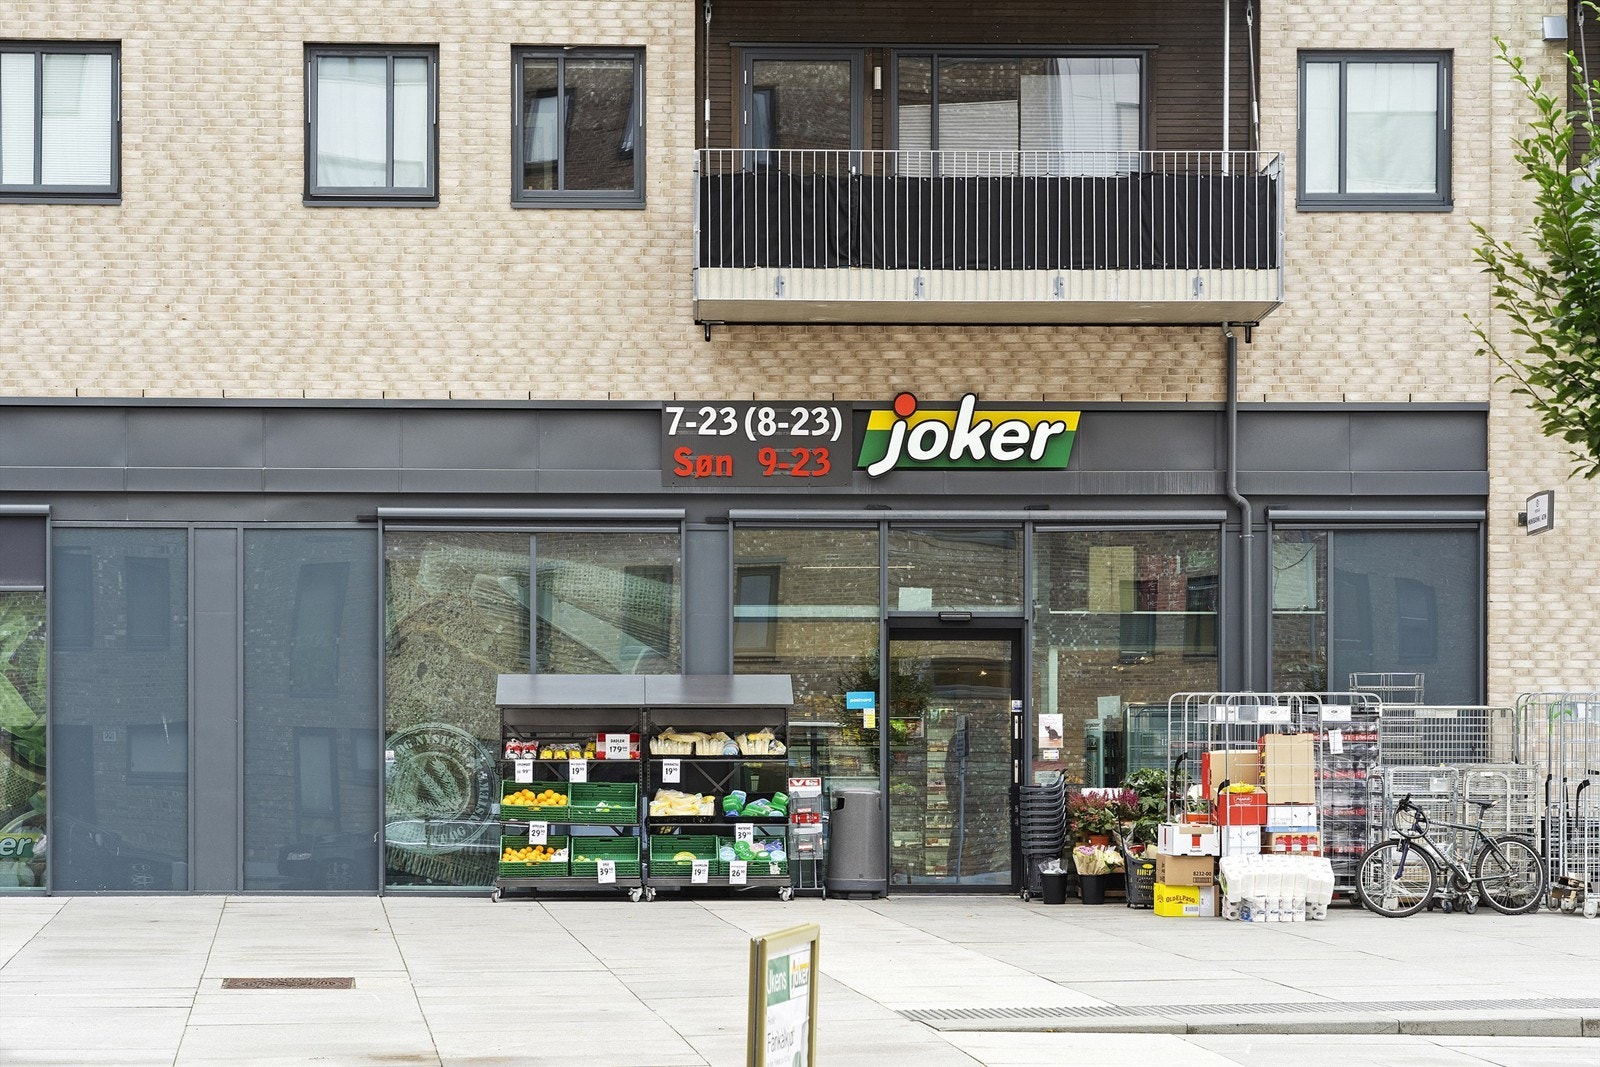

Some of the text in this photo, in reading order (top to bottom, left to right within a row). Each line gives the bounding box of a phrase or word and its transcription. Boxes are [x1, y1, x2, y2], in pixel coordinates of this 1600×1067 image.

[666, 406, 842, 442] 7-23 (8-23)
[866, 392, 1067, 478] joker
[673, 446, 831, 478] Søn 9-23
